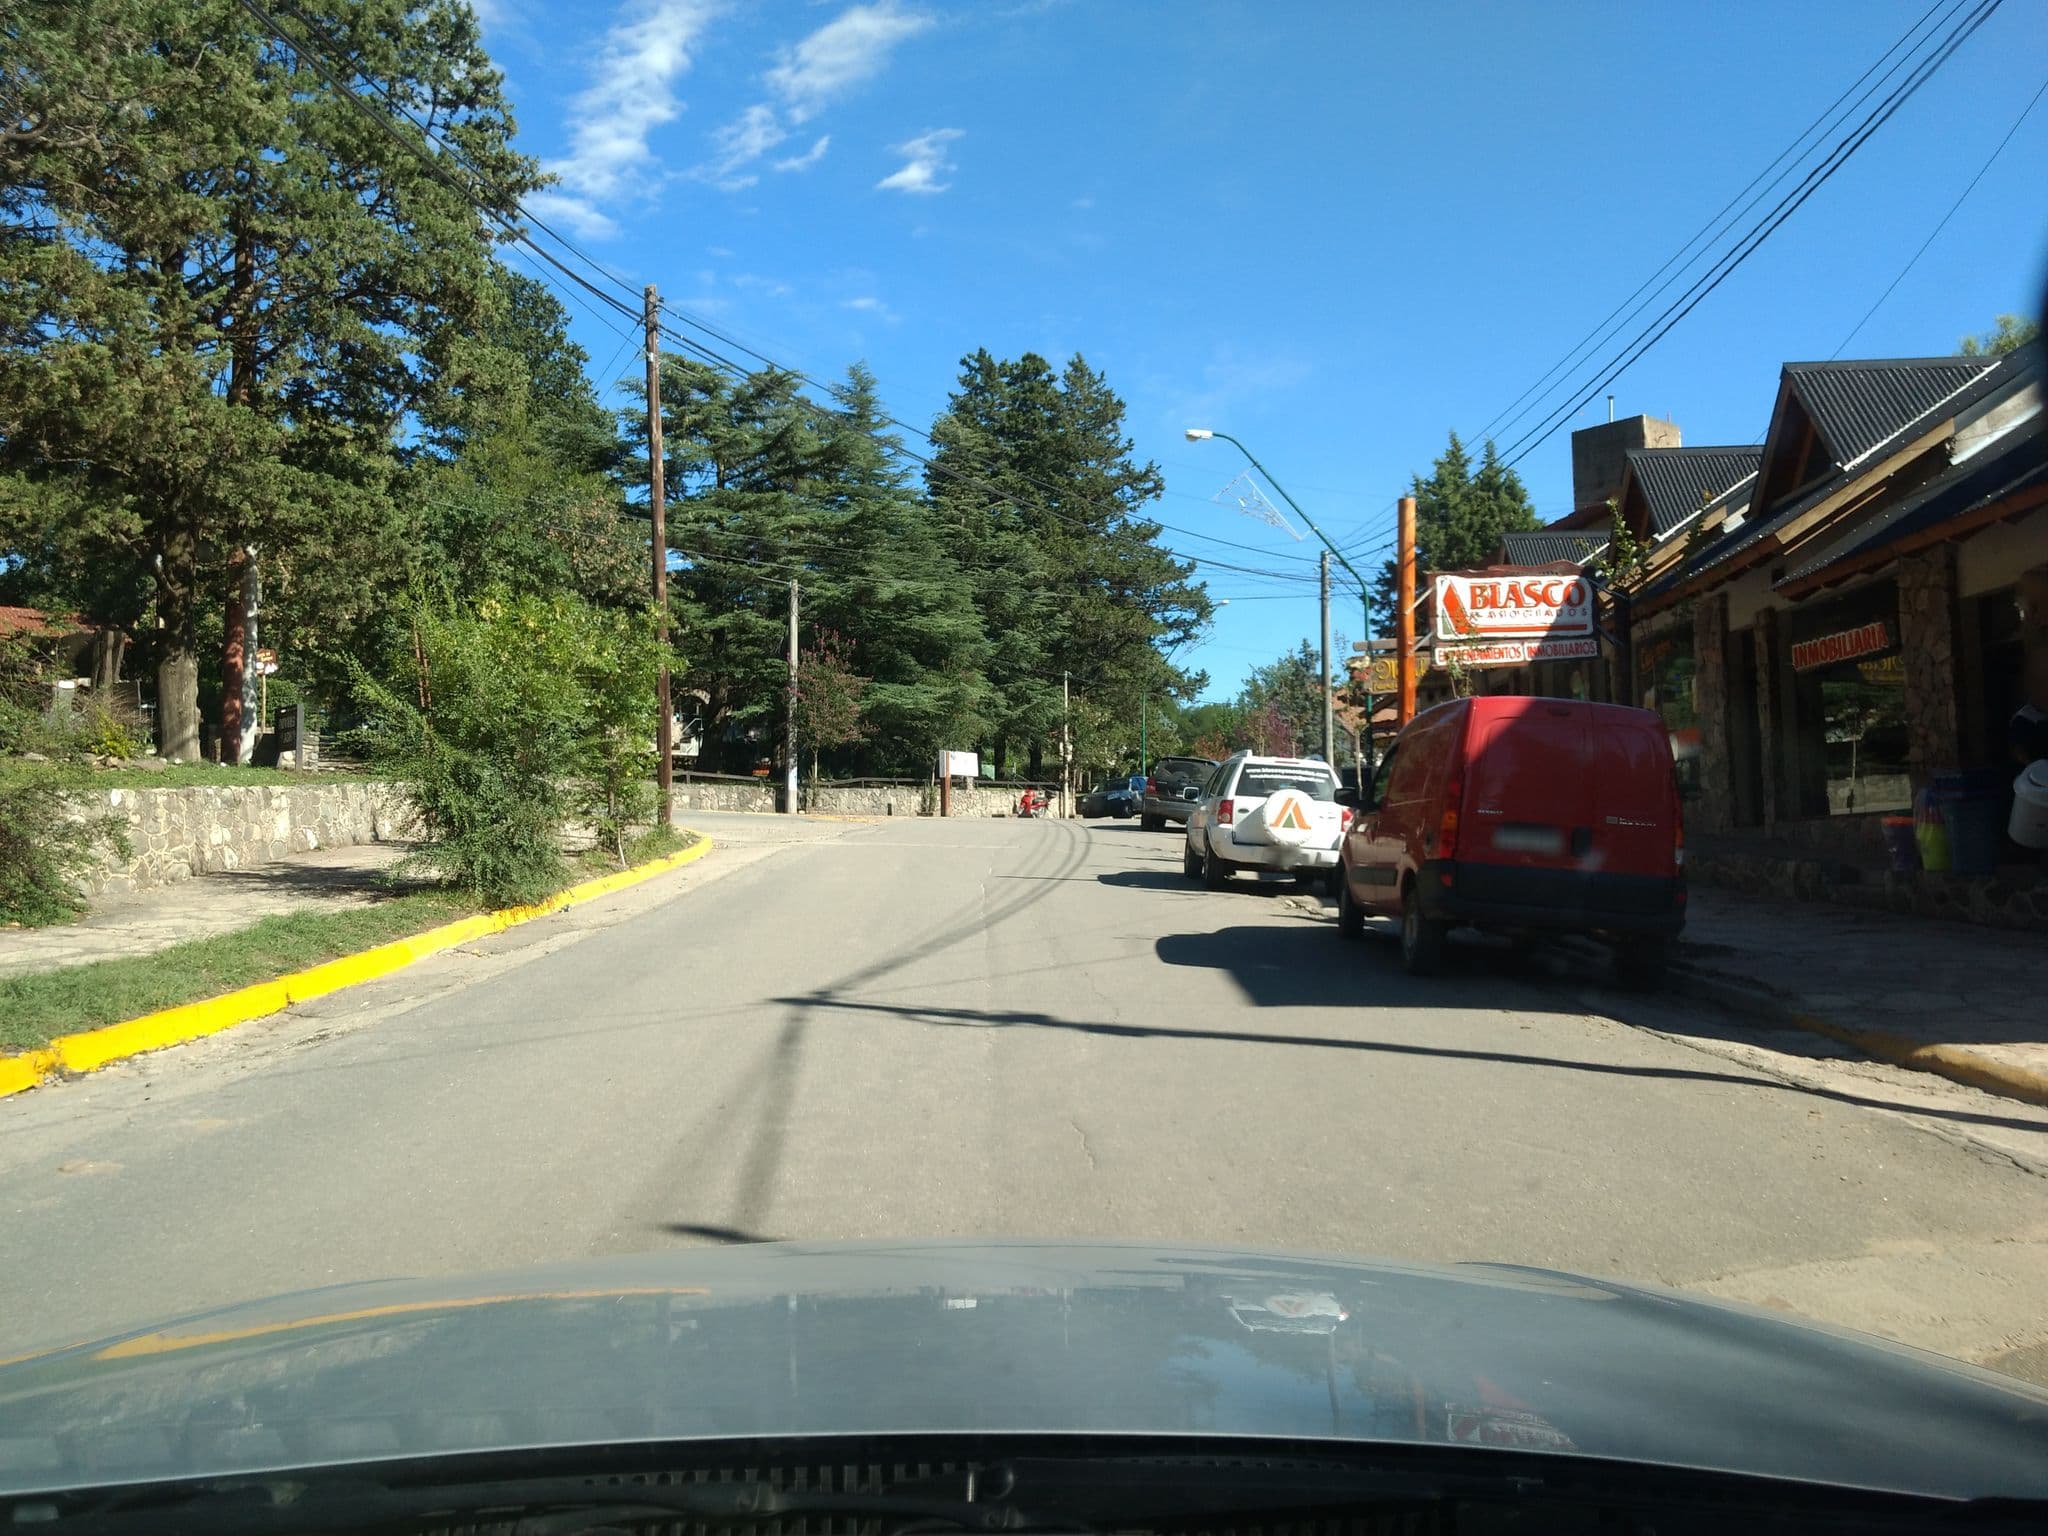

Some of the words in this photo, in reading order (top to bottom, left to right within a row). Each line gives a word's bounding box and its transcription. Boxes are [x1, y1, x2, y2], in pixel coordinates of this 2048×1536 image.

[1469, 580, 1585, 609] BLASCO
[1488, 608, 1587, 619] ASOCIADOS
[1528, 641, 1595, 658] INMOBILIARIOS
[1792, 622, 1889, 671] INMOBILIARIA
